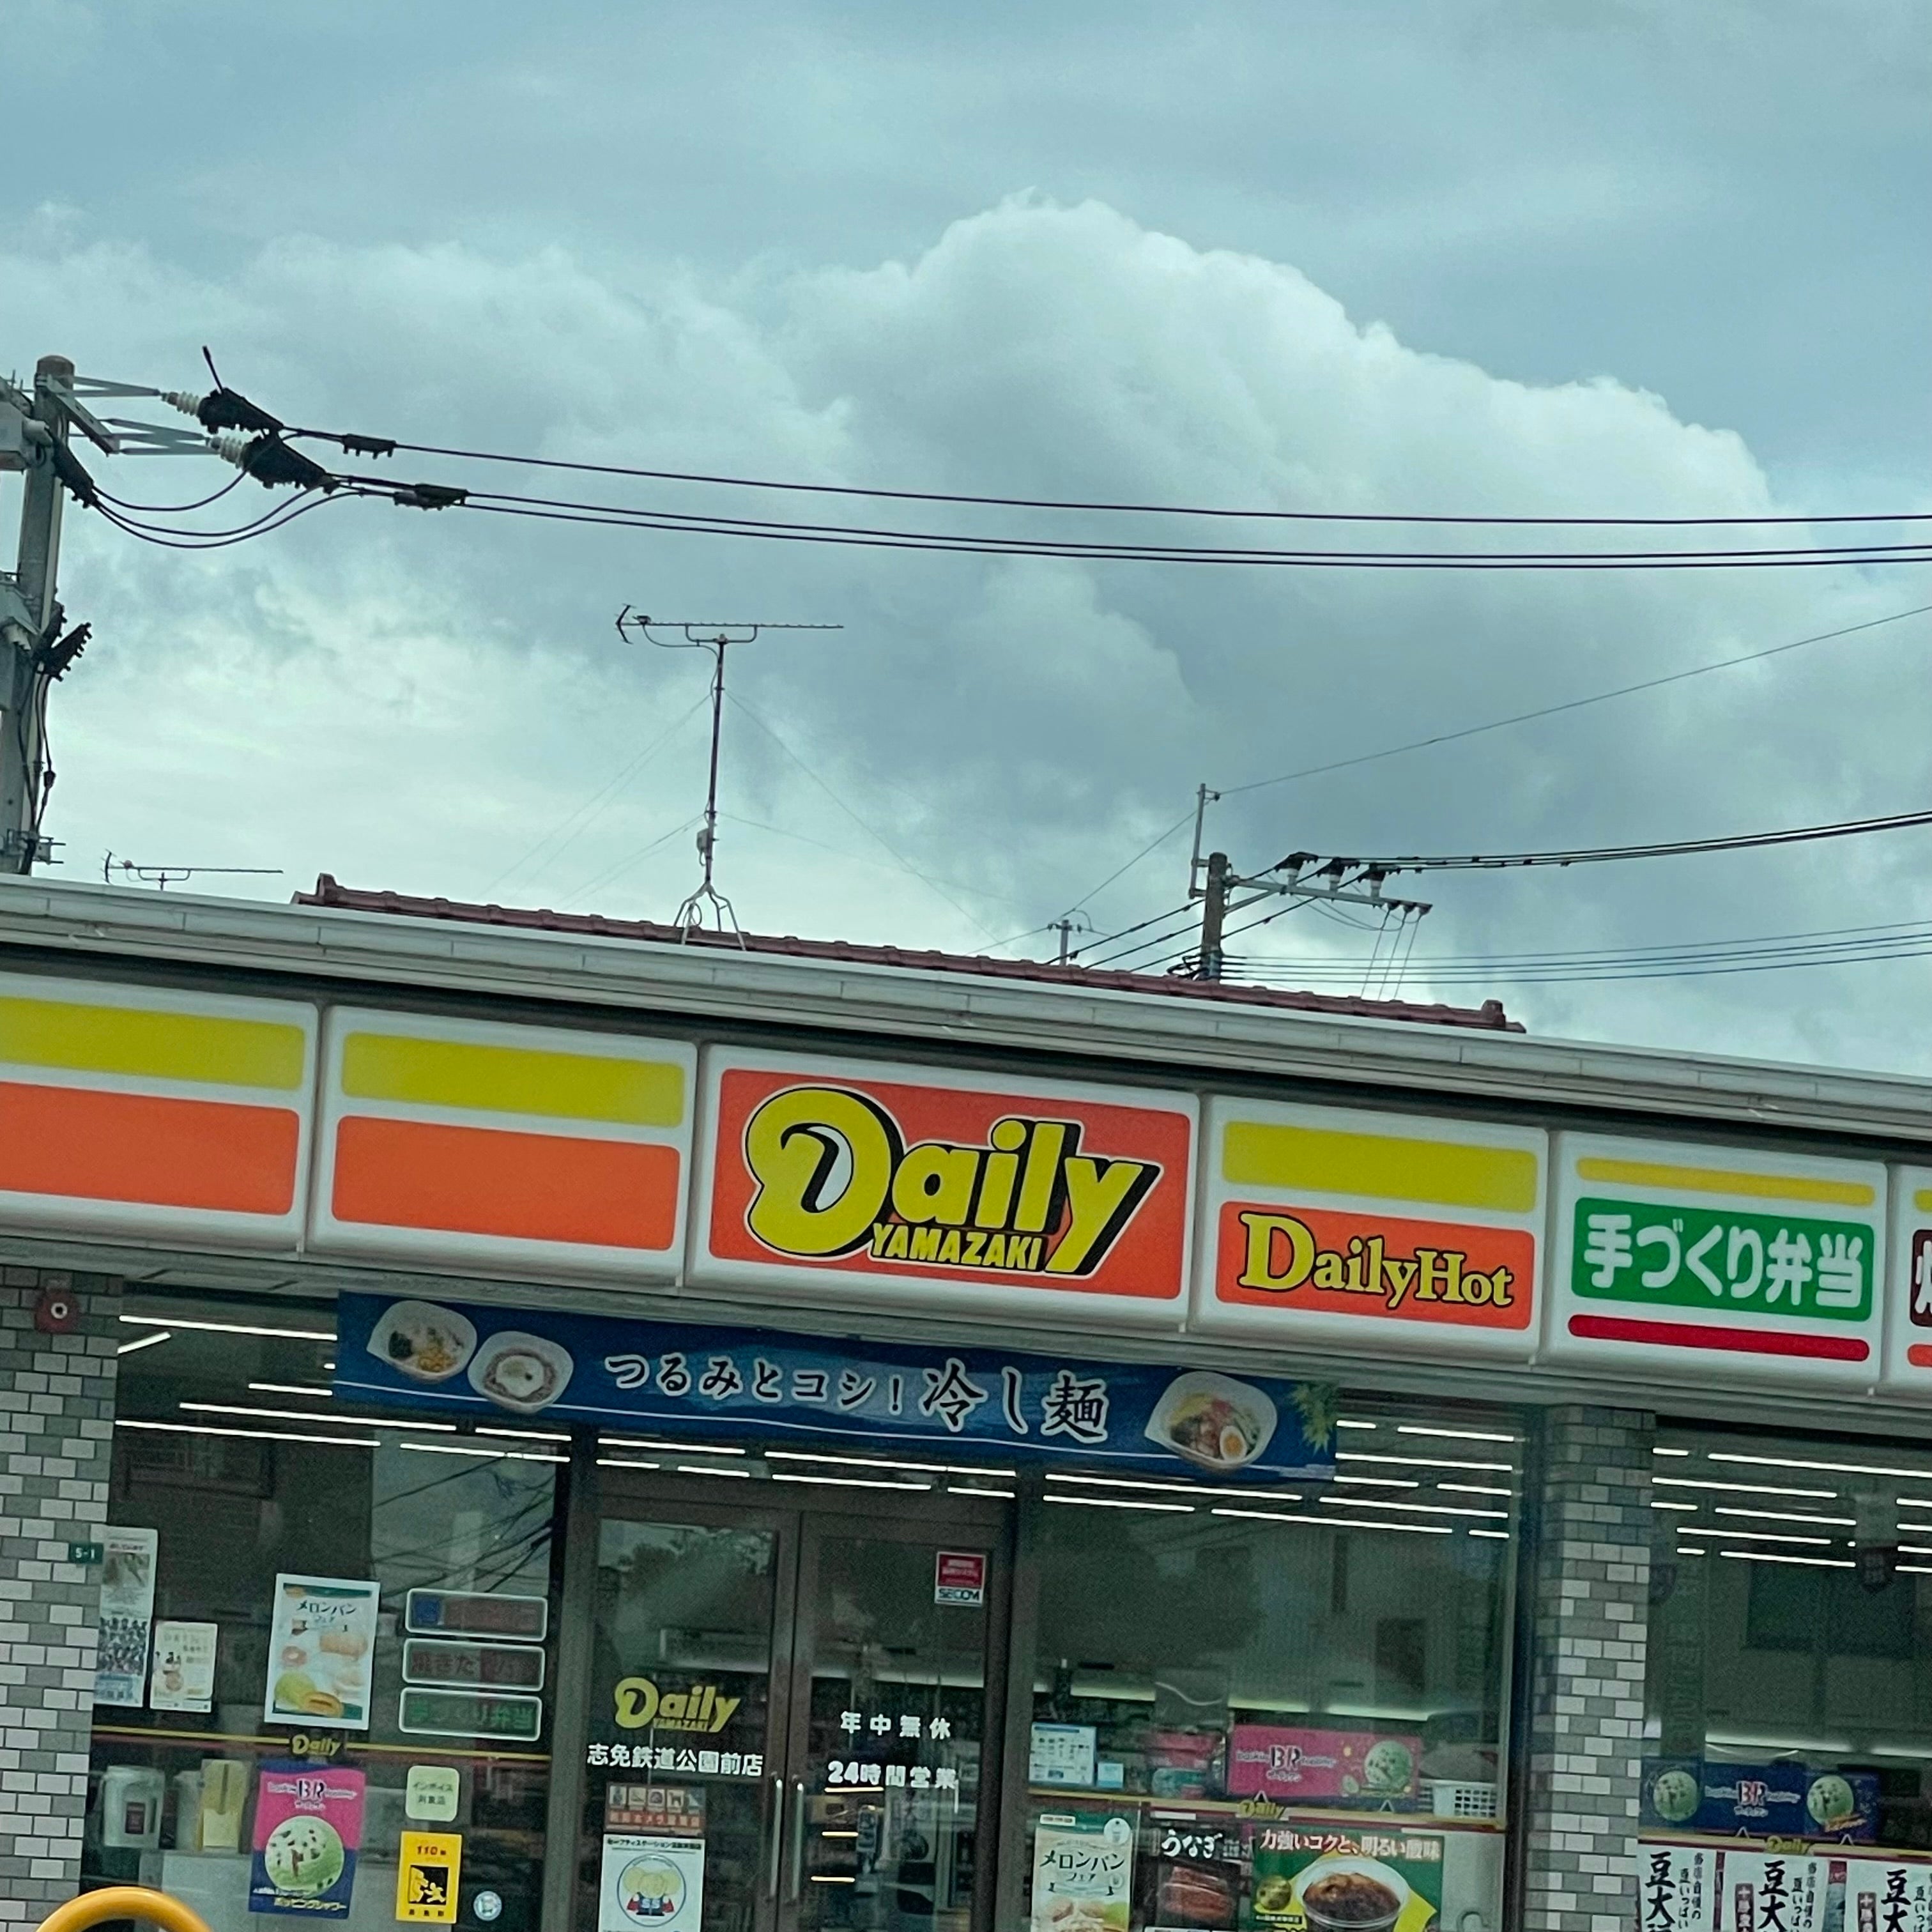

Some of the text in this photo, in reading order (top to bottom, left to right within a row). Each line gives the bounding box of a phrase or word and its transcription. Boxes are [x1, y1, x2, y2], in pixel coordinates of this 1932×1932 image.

[745, 1086, 1160, 1275] Daily
[870, 1221, 1047, 1271] YAMAZAKI
[1239, 1211, 1514, 1309] DailyHot
[1584, 1214, 1862, 1308] 手づくり弁当
[296, 1600, 356, 1616] メロンパン
[939, 1588, 979, 1600] SECOM
[614, 1676, 740, 1733] Daily
[840, 1711, 951, 1740] 年中無休
[291, 1733, 343, 1756] Daily
[1269, 1745, 1302, 1770] BR
[586, 1743, 764, 1777] 志免鉄道公園前店
[297, 1778, 326, 1800] BR
[827, 1760, 959, 1790] 24時間営業
[1736, 1780, 1768, 1806] BR
[1161, 1828, 1223, 1859] うなぎ
[1767, 1836, 1810, 1854] Daily
[1039, 1850, 1125, 1871] メロンパン
